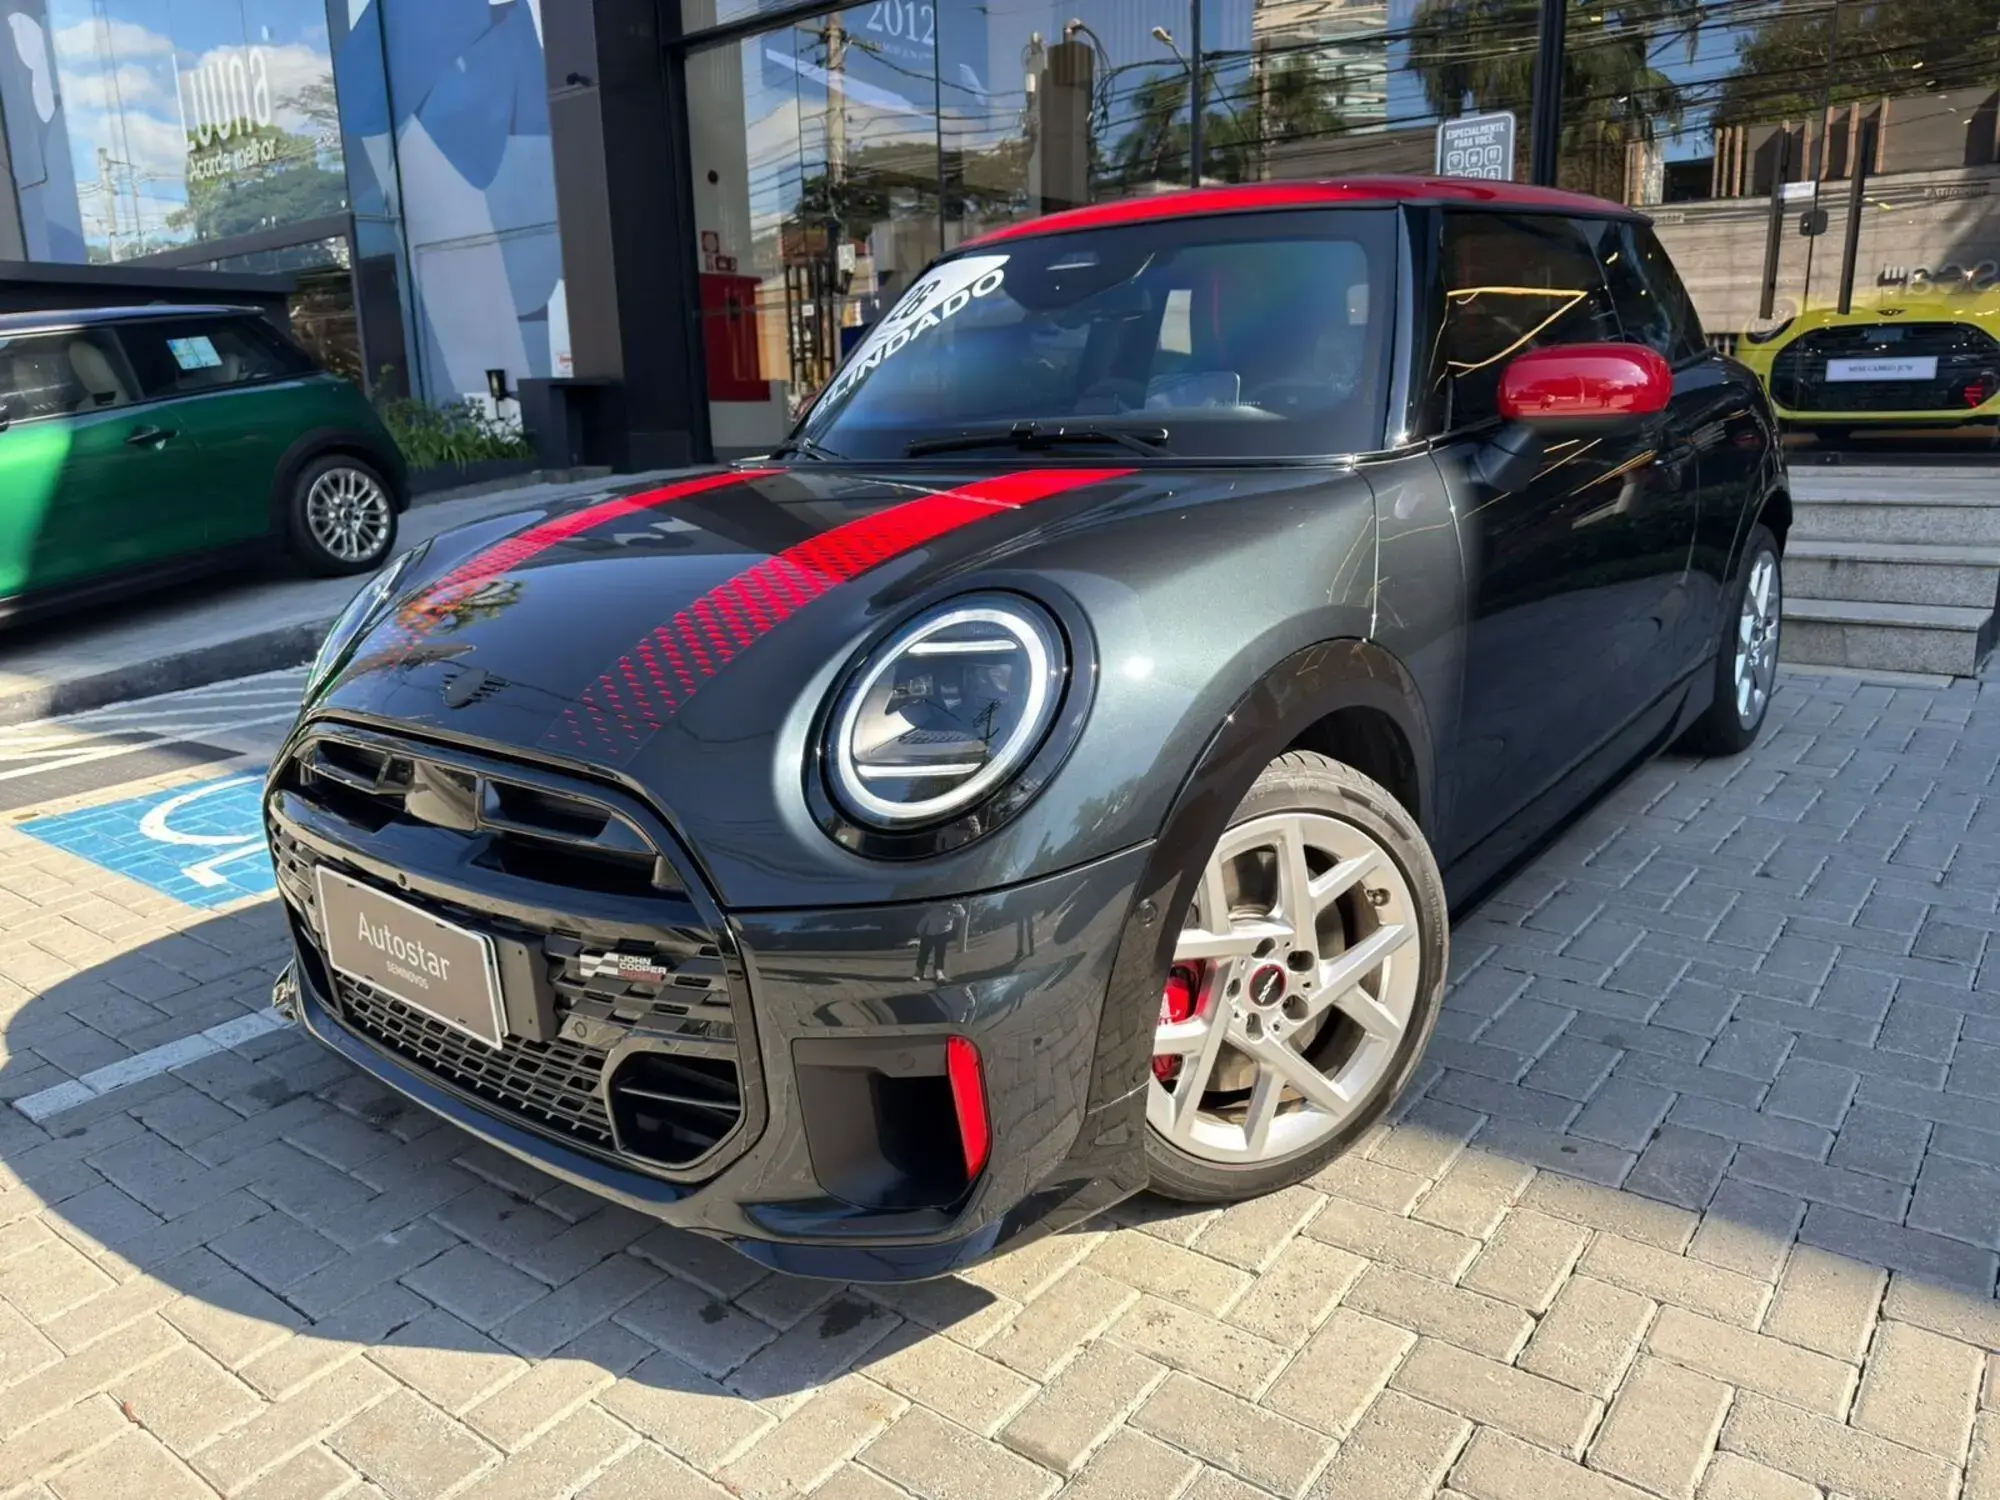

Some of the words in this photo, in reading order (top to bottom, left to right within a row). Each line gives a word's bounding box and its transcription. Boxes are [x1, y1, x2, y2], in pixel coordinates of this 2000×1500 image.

[866, 0, 935, 46] 2012
[190, 149, 231, 182] Acorde
[233, 138, 276, 170] melhor
[358, 911, 450, 981] Autostar
[619, 962, 667, 974] COOPER
[620, 955, 652, 966] JOHN
